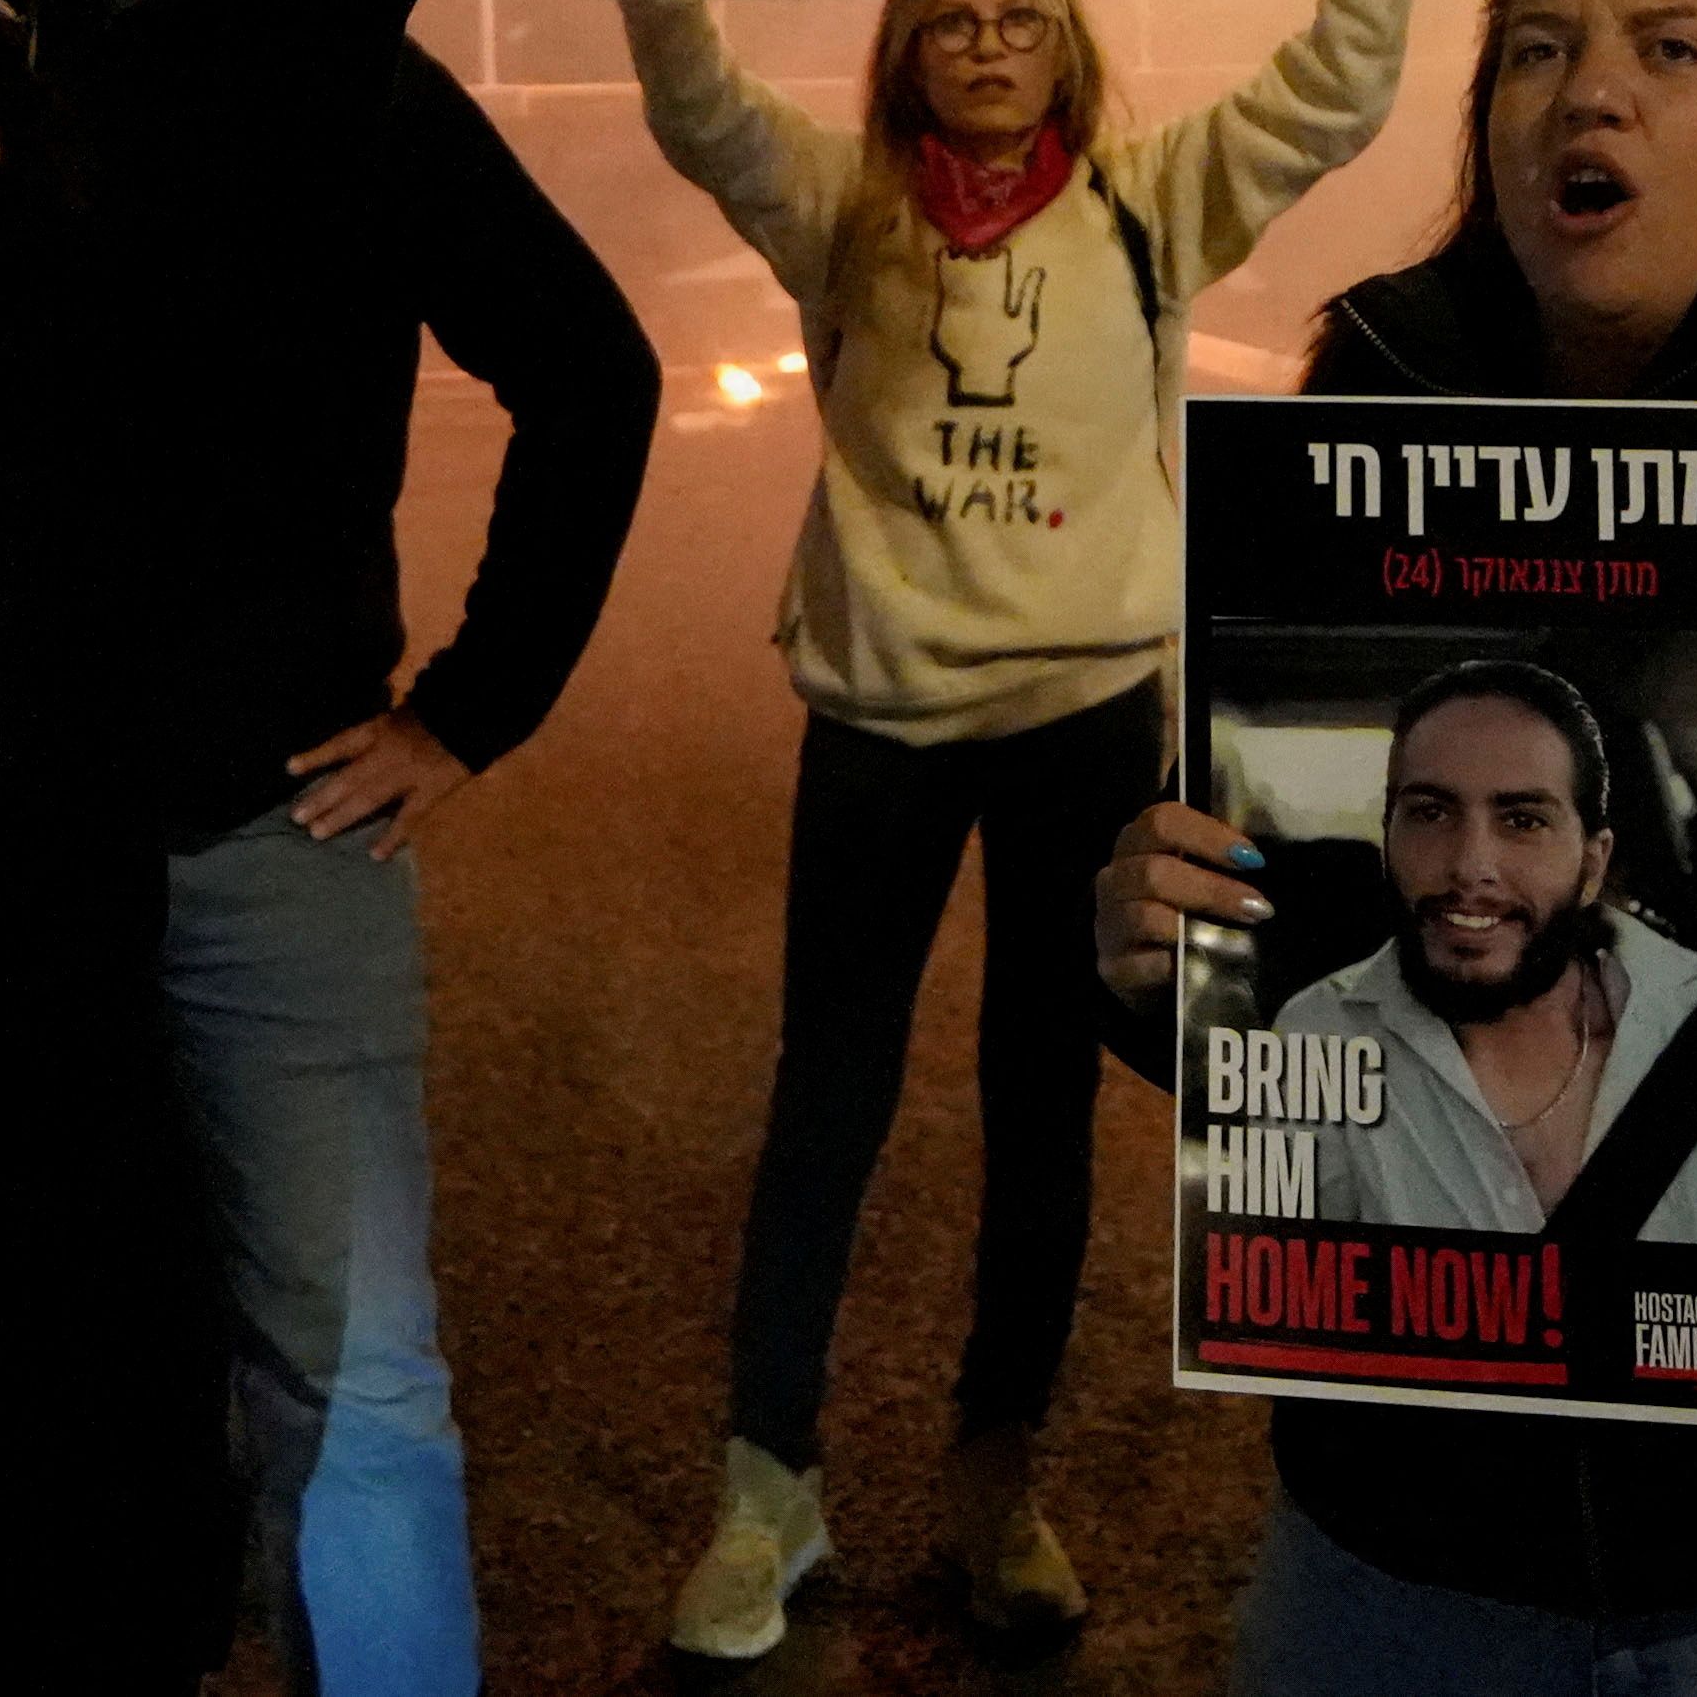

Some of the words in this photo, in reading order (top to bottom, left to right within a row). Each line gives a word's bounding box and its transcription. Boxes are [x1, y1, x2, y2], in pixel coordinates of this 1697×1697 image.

[932, 420, 1039, 472] THE
[1307, 442, 1381, 518] חי
[1402, 443, 1572, 536] עדיין
[1383, 546, 1443, 597] (24)
[1454, 556, 1585, 597] צנגאוקר
[1593, 558, 1659, 602] מתן
[1207, 1026, 1386, 1126] BRING
[1206, 1124, 1318, 1220] HIM
[1205, 1232, 1371, 1333] HOME
[1391, 1243, 1564, 1349] NOW!
